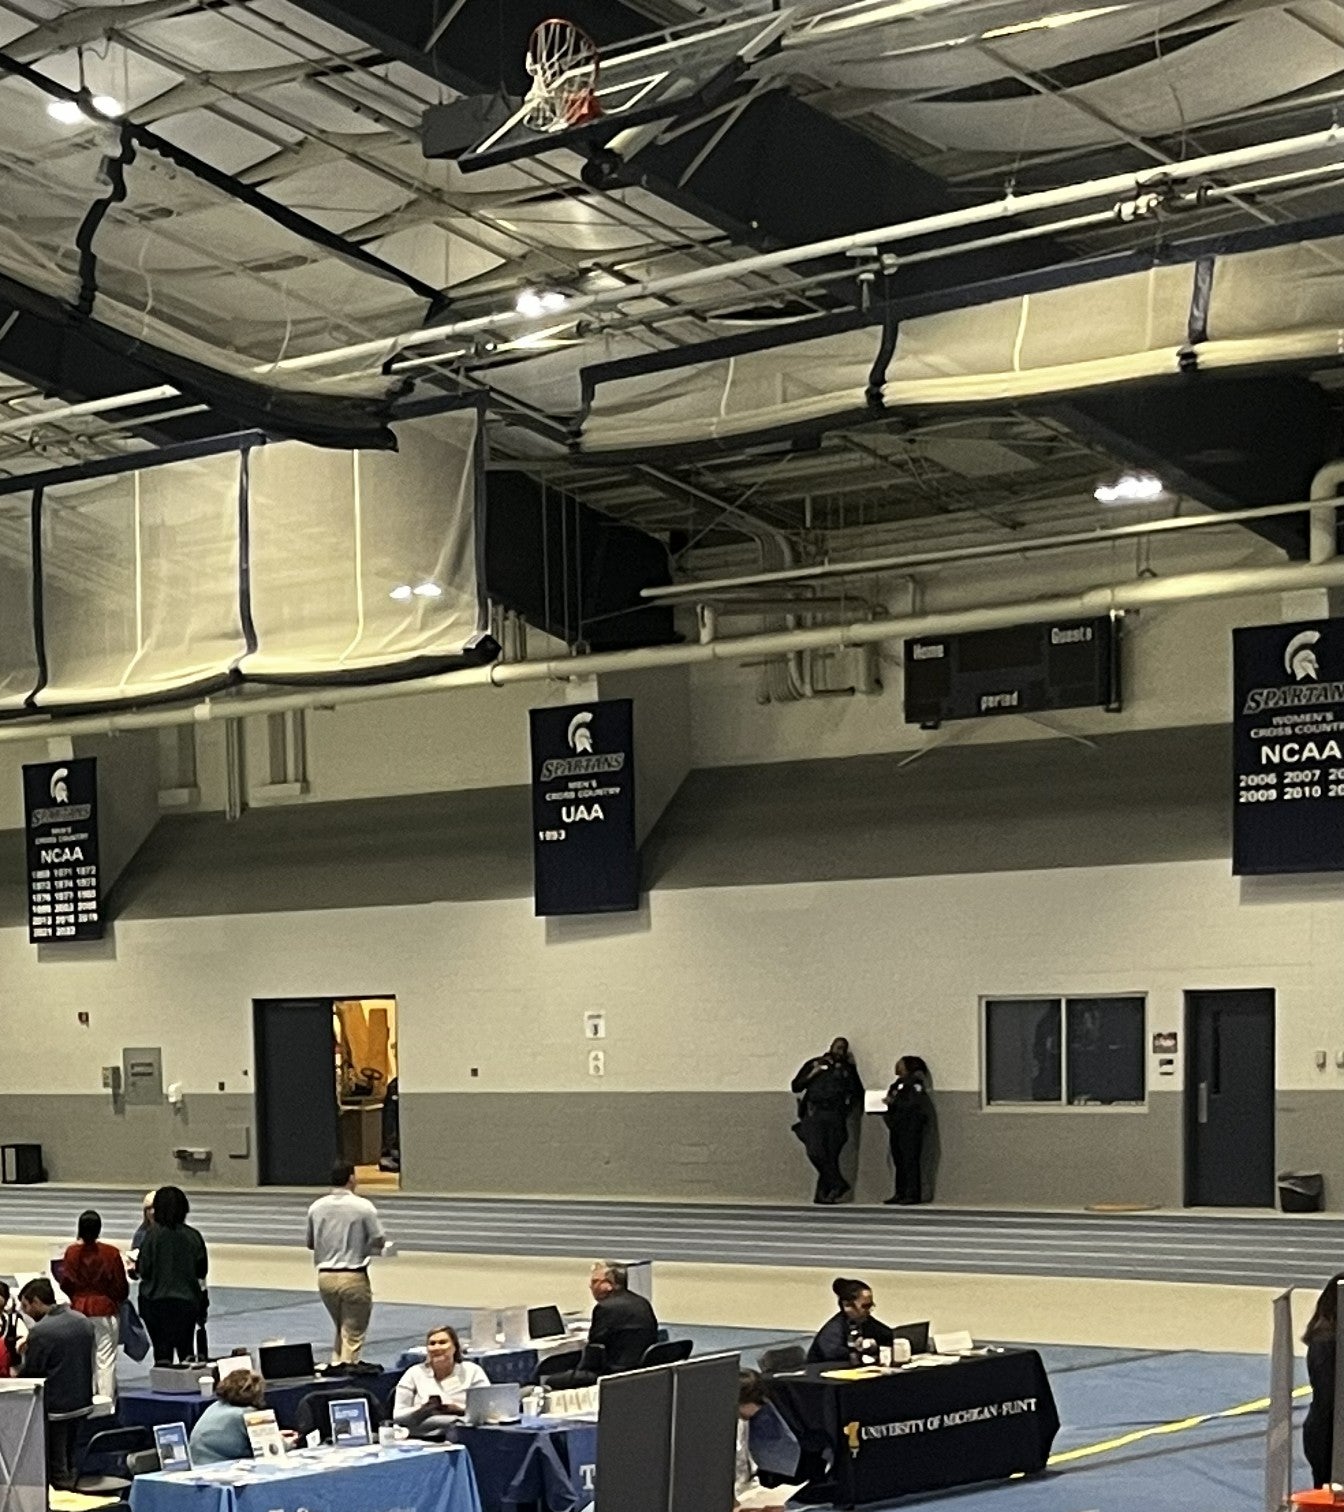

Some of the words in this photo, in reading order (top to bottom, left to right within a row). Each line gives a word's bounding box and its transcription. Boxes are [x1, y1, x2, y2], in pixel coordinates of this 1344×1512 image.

[1250, 726, 1293, 739] CROSS
[1261, 740, 1342, 765] NCAA
[1239, 773, 1277, 787] 2006
[1283, 769, 1321, 784] 2007
[1328, 768, 1344, 782] 20
[1283, 785, 1321, 800] 2010
[1328, 784, 1344, 797] 20
[561, 803, 605, 823] UAA
[40, 847, 84, 864] NCAA
[862, 1418, 925, 1441] UNIVERSITY
[927, 1414, 942, 1431] OF
